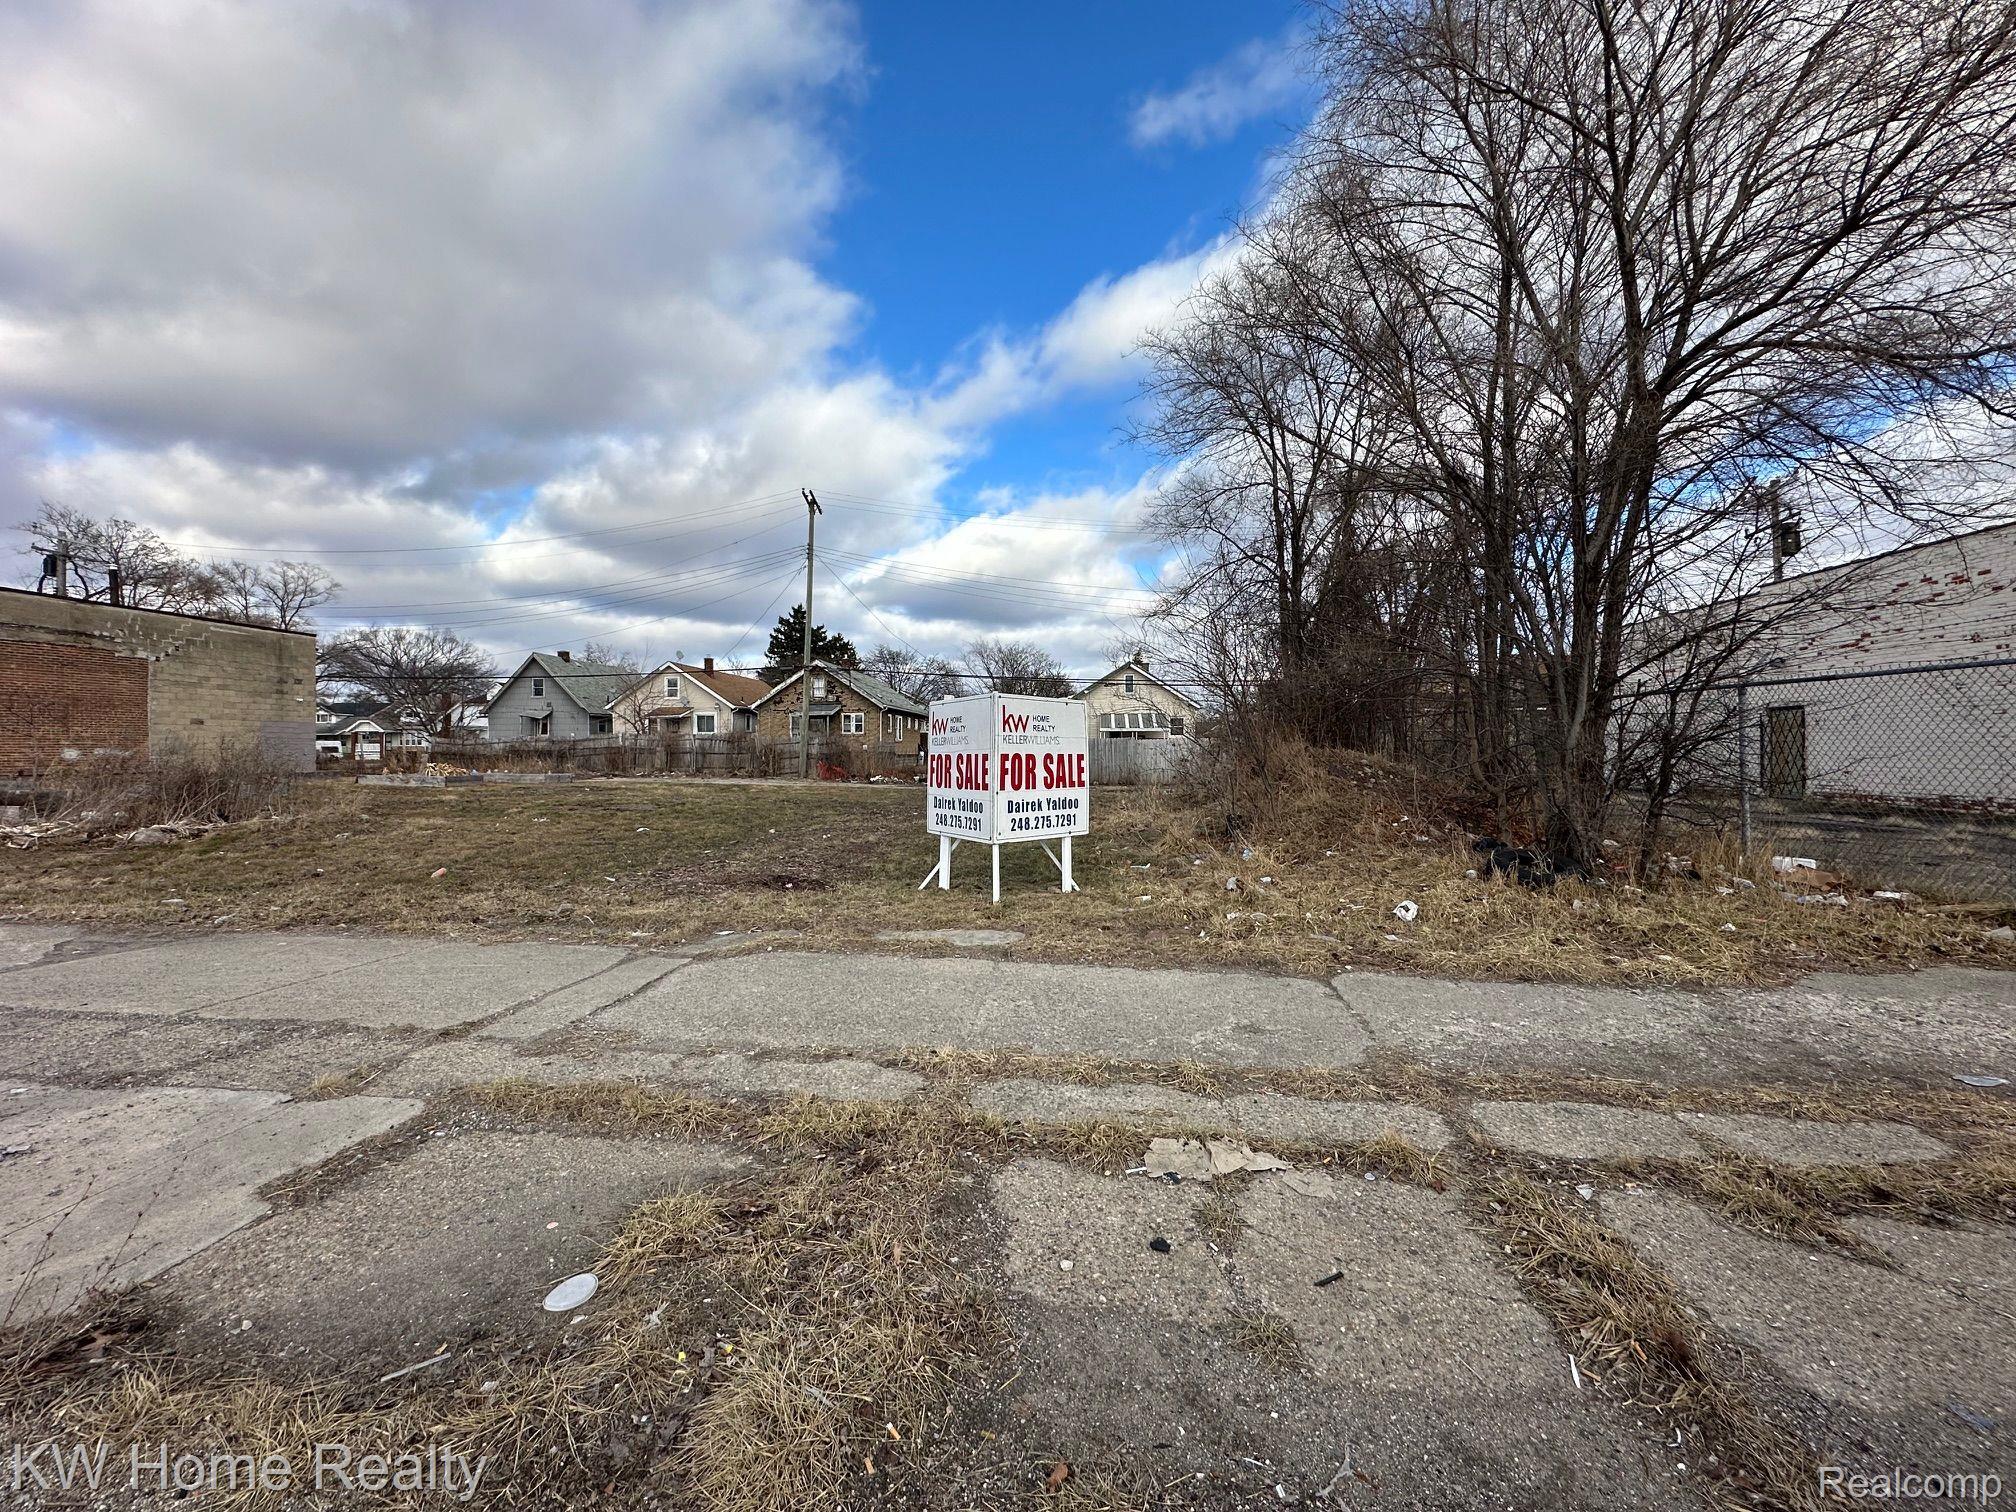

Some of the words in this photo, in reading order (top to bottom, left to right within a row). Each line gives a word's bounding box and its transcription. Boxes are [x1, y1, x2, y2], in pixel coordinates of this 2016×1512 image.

[931, 711, 949, 736] kw
[950, 715, 963, 724] HOME
[1002, 704, 1030, 733] kw
[1032, 714, 1050, 723] HOME
[950, 725, 967, 733] REALTY
[1032, 724, 1056, 733] REALTY
[929, 753, 952, 789] FOR
[956, 752, 989, 791] SALE
[999, 752, 1037, 792] FOR
[1042, 752, 1086, 790] SALE
[933, 796, 956, 811] Dairek
[957, 797, 984, 814] Yaldoo
[1007, 798, 1043, 814] Dairek
[1046, 796, 1079, 811] Yaldoo
[935, 812, 982, 832] 248.275.7291
[1010, 813, 1077, 832] 248.275.7291
